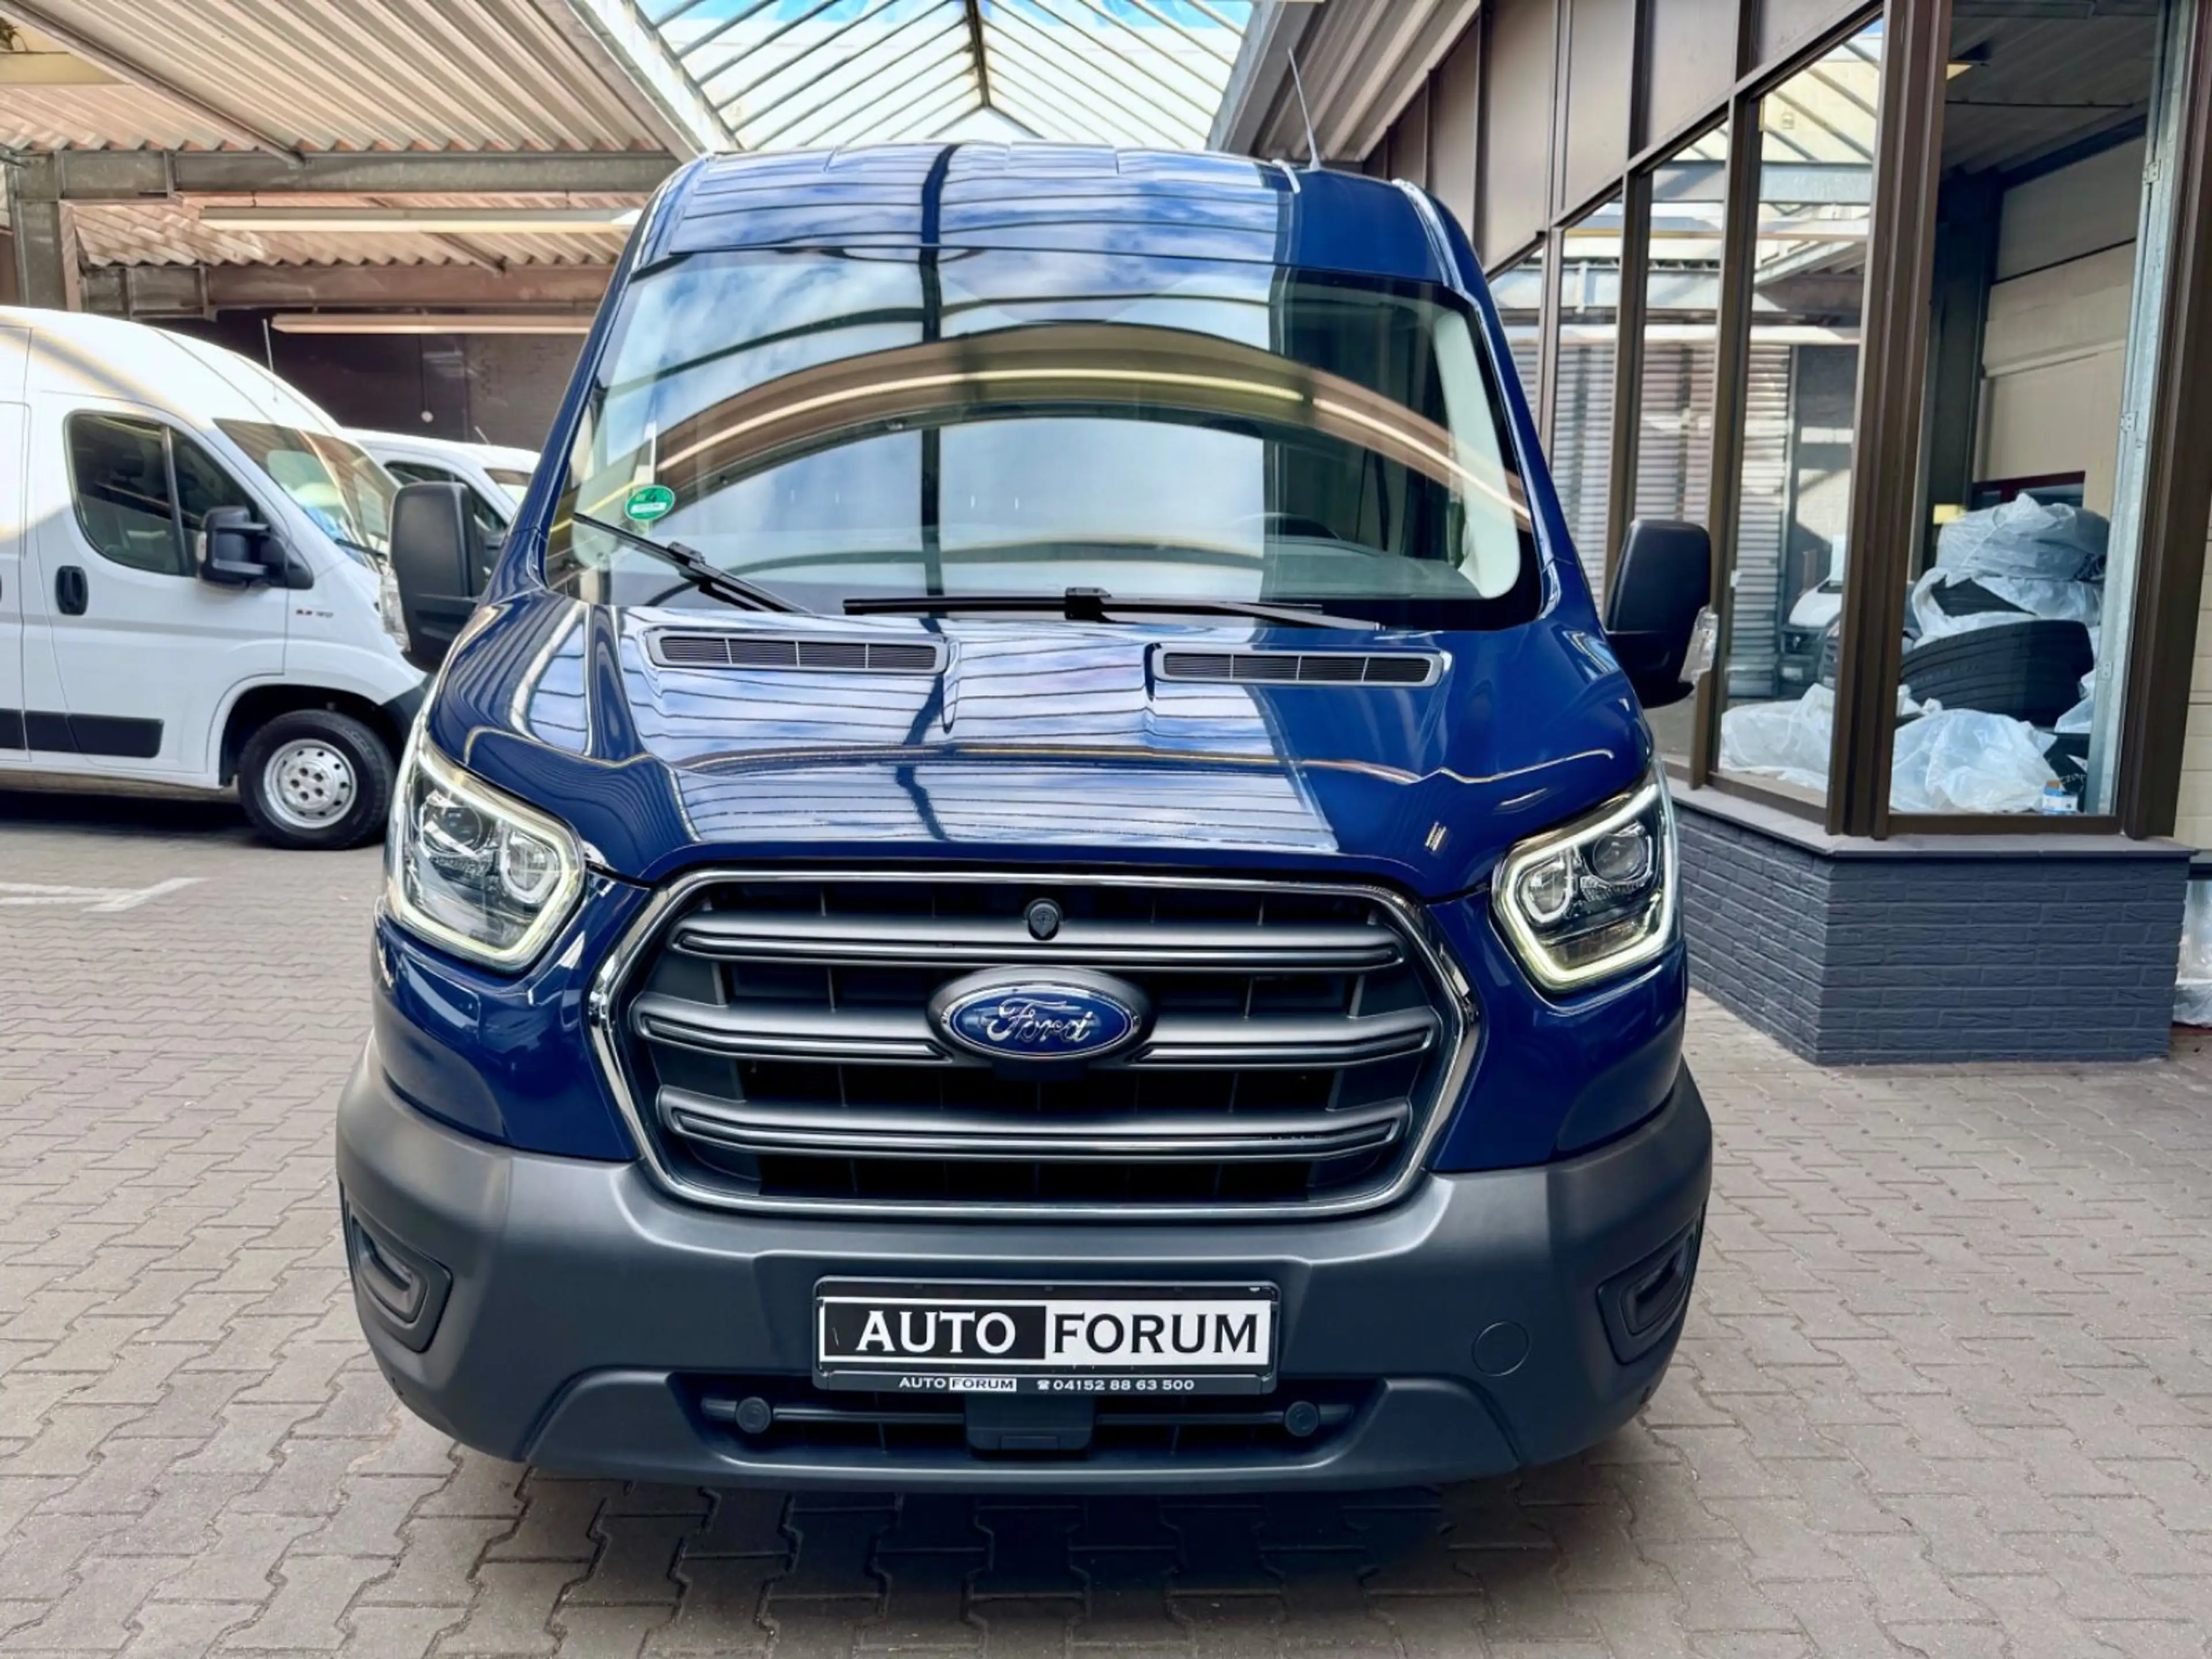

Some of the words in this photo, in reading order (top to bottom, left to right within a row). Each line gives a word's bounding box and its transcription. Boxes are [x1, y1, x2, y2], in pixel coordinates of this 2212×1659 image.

[987, 998, 1094, 1043] Ford
[855, 1310, 1016, 1354] AUTO
[1053, 1312, 1259, 1354] FORUM
[899, 1376, 946, 1389] AUTO
[952, 1378, 1014, 1389] FORUM
[1053, 1380, 1105, 1391] 04152
[1109, 1380, 1131, 1391] 88
[1135, 1380, 1157, 1391] 63
[1161, 1380, 1195, 1391] 500
